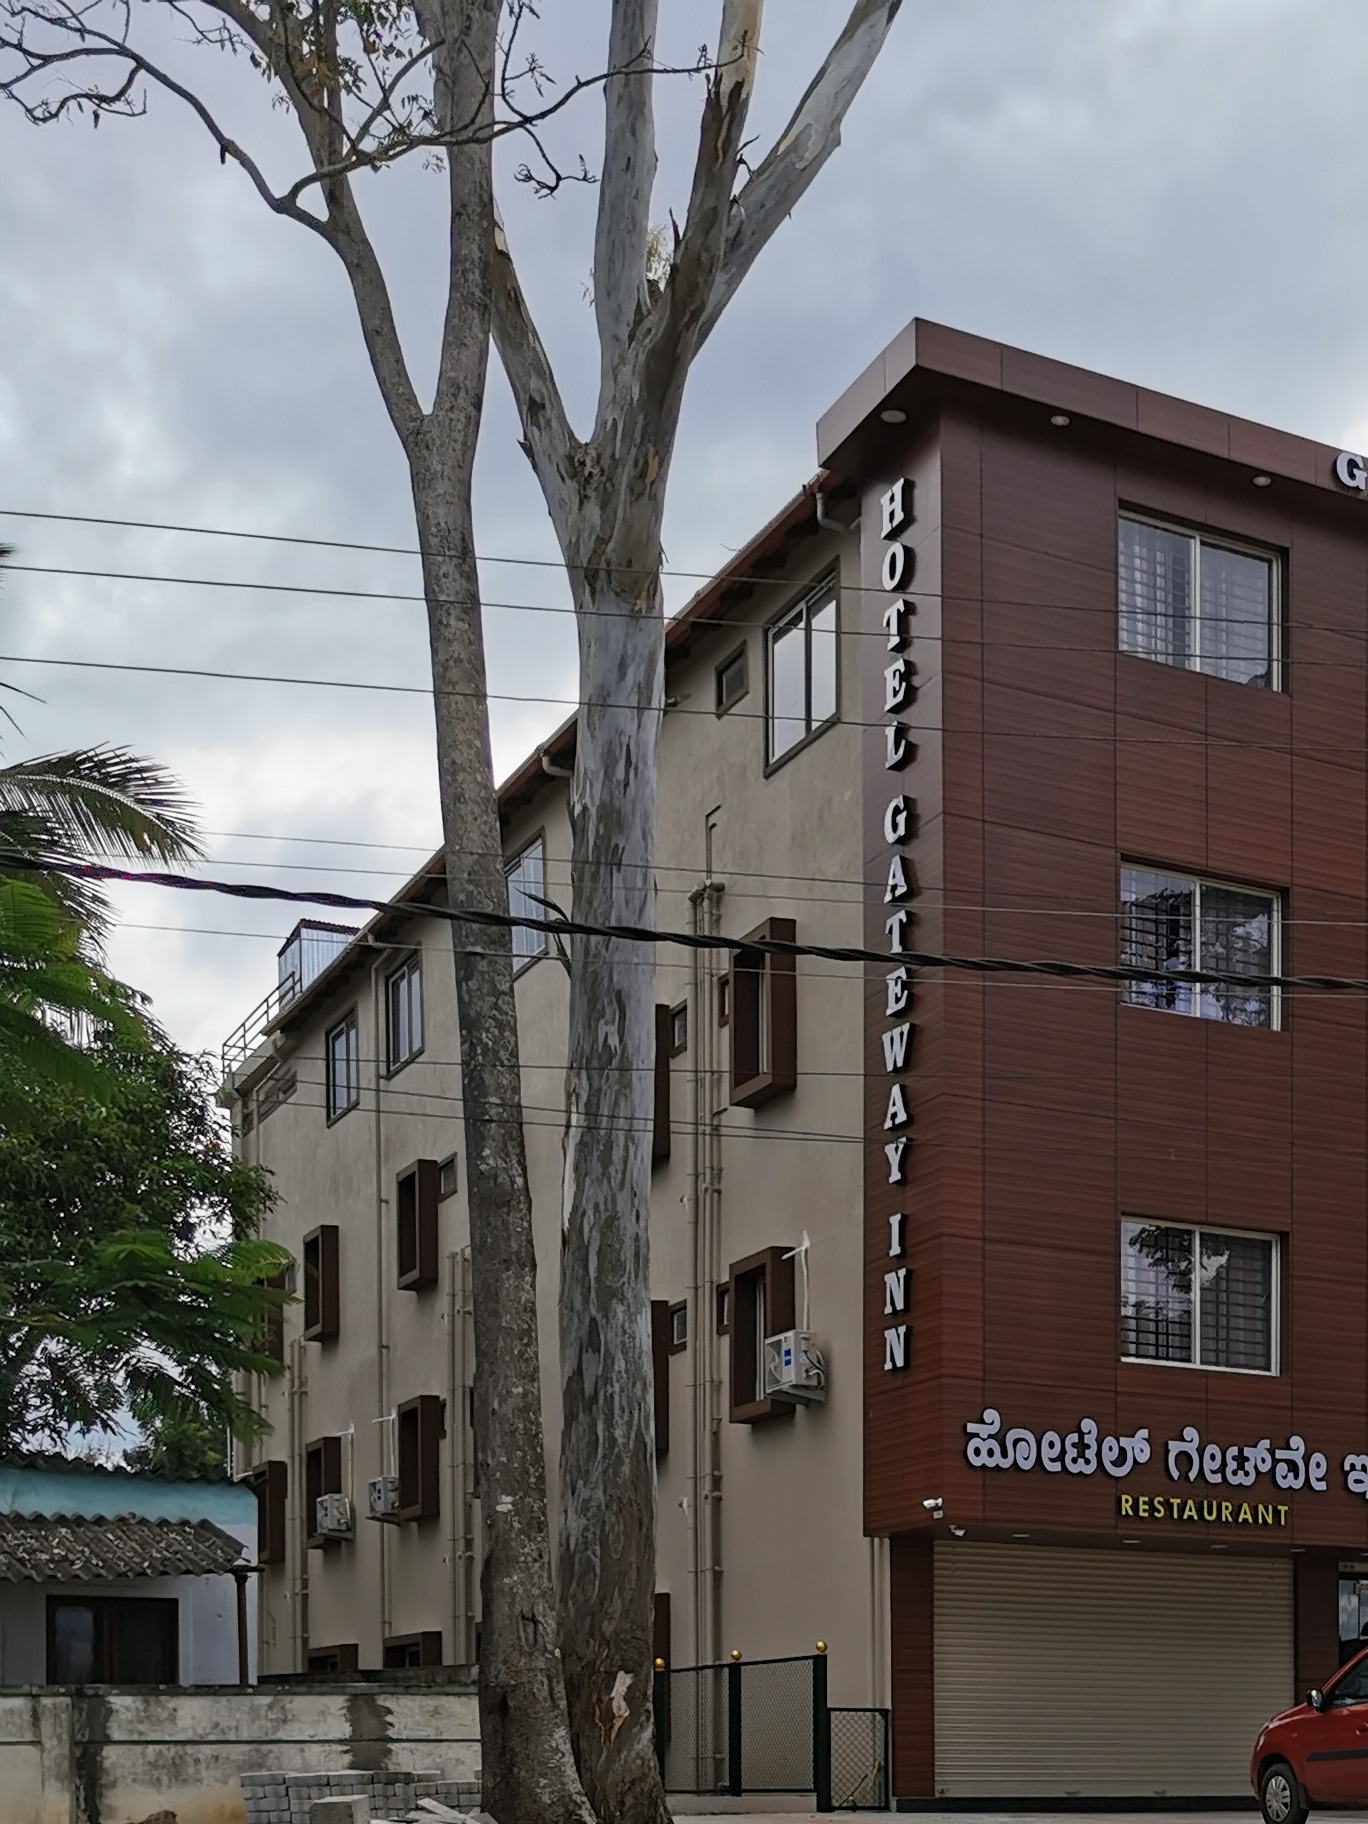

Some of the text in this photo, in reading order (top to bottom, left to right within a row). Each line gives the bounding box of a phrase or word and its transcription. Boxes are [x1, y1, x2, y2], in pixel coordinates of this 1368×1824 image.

[880, 476, 911, 1371] HOTEL GATEWAY INN
[966, 1408, 1151, 1478] ಹೋಟೆಲ್
[1120, 1494, 1289, 1527] RESTAURANT
